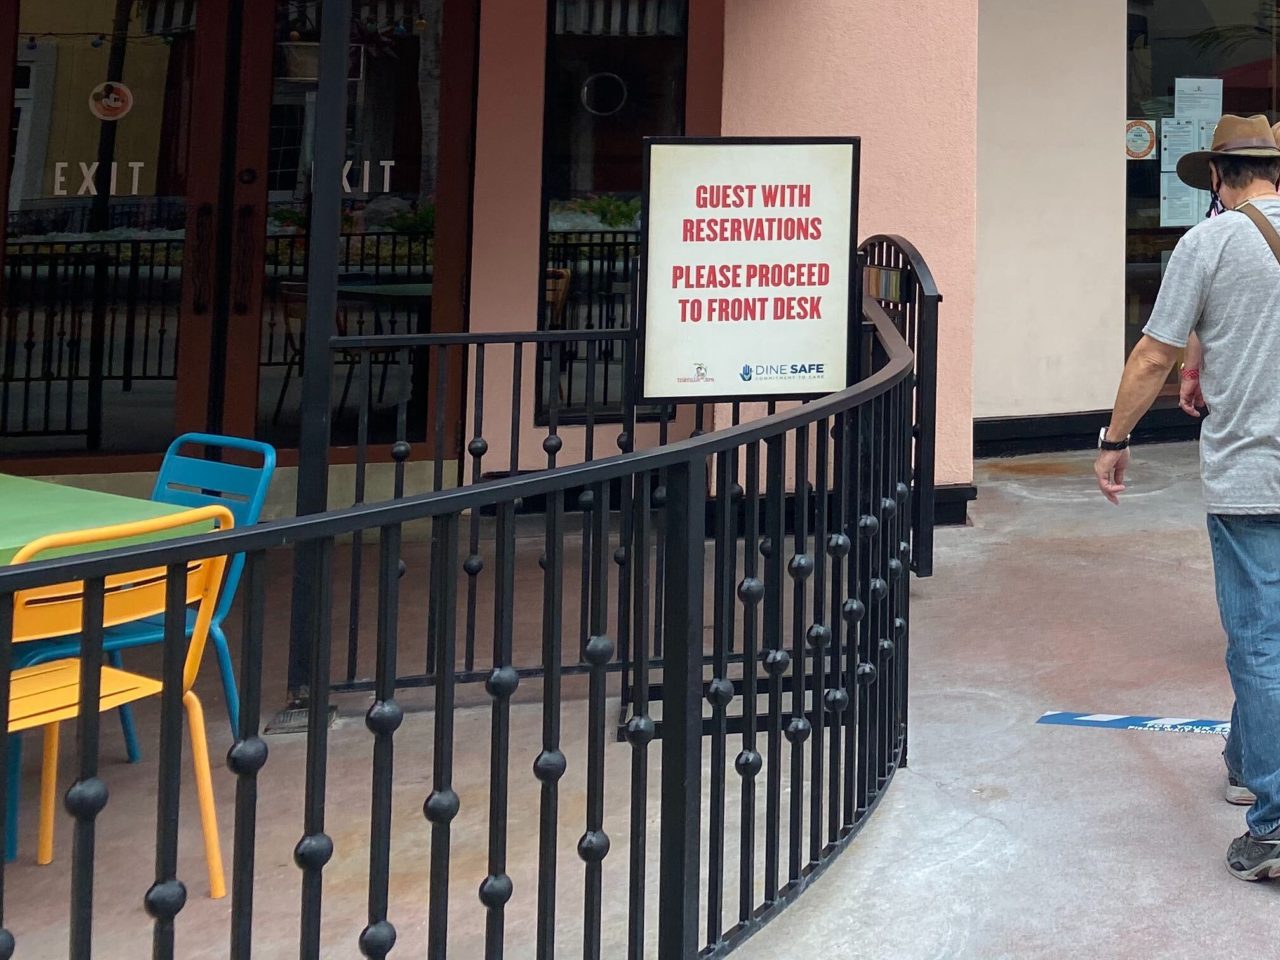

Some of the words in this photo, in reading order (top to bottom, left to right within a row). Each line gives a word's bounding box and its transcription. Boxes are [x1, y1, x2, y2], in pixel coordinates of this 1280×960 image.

[53, 161, 145, 196] EXIT
[311, 160, 396, 193] XIT
[695, 184, 757, 208] GUEST
[761, 184, 811, 208] WITH
[682, 217, 822, 242] RESERVATIONS
[672, 264, 742, 289] PLEASE
[746, 263, 830, 288] PROCEED
[678, 298, 702, 322] TO
[707, 297, 769, 322] FRONT
[773, 296, 822, 321] DESK
[755, 364, 788, 376] DINE
[790, 363, 825, 374] SAFE
